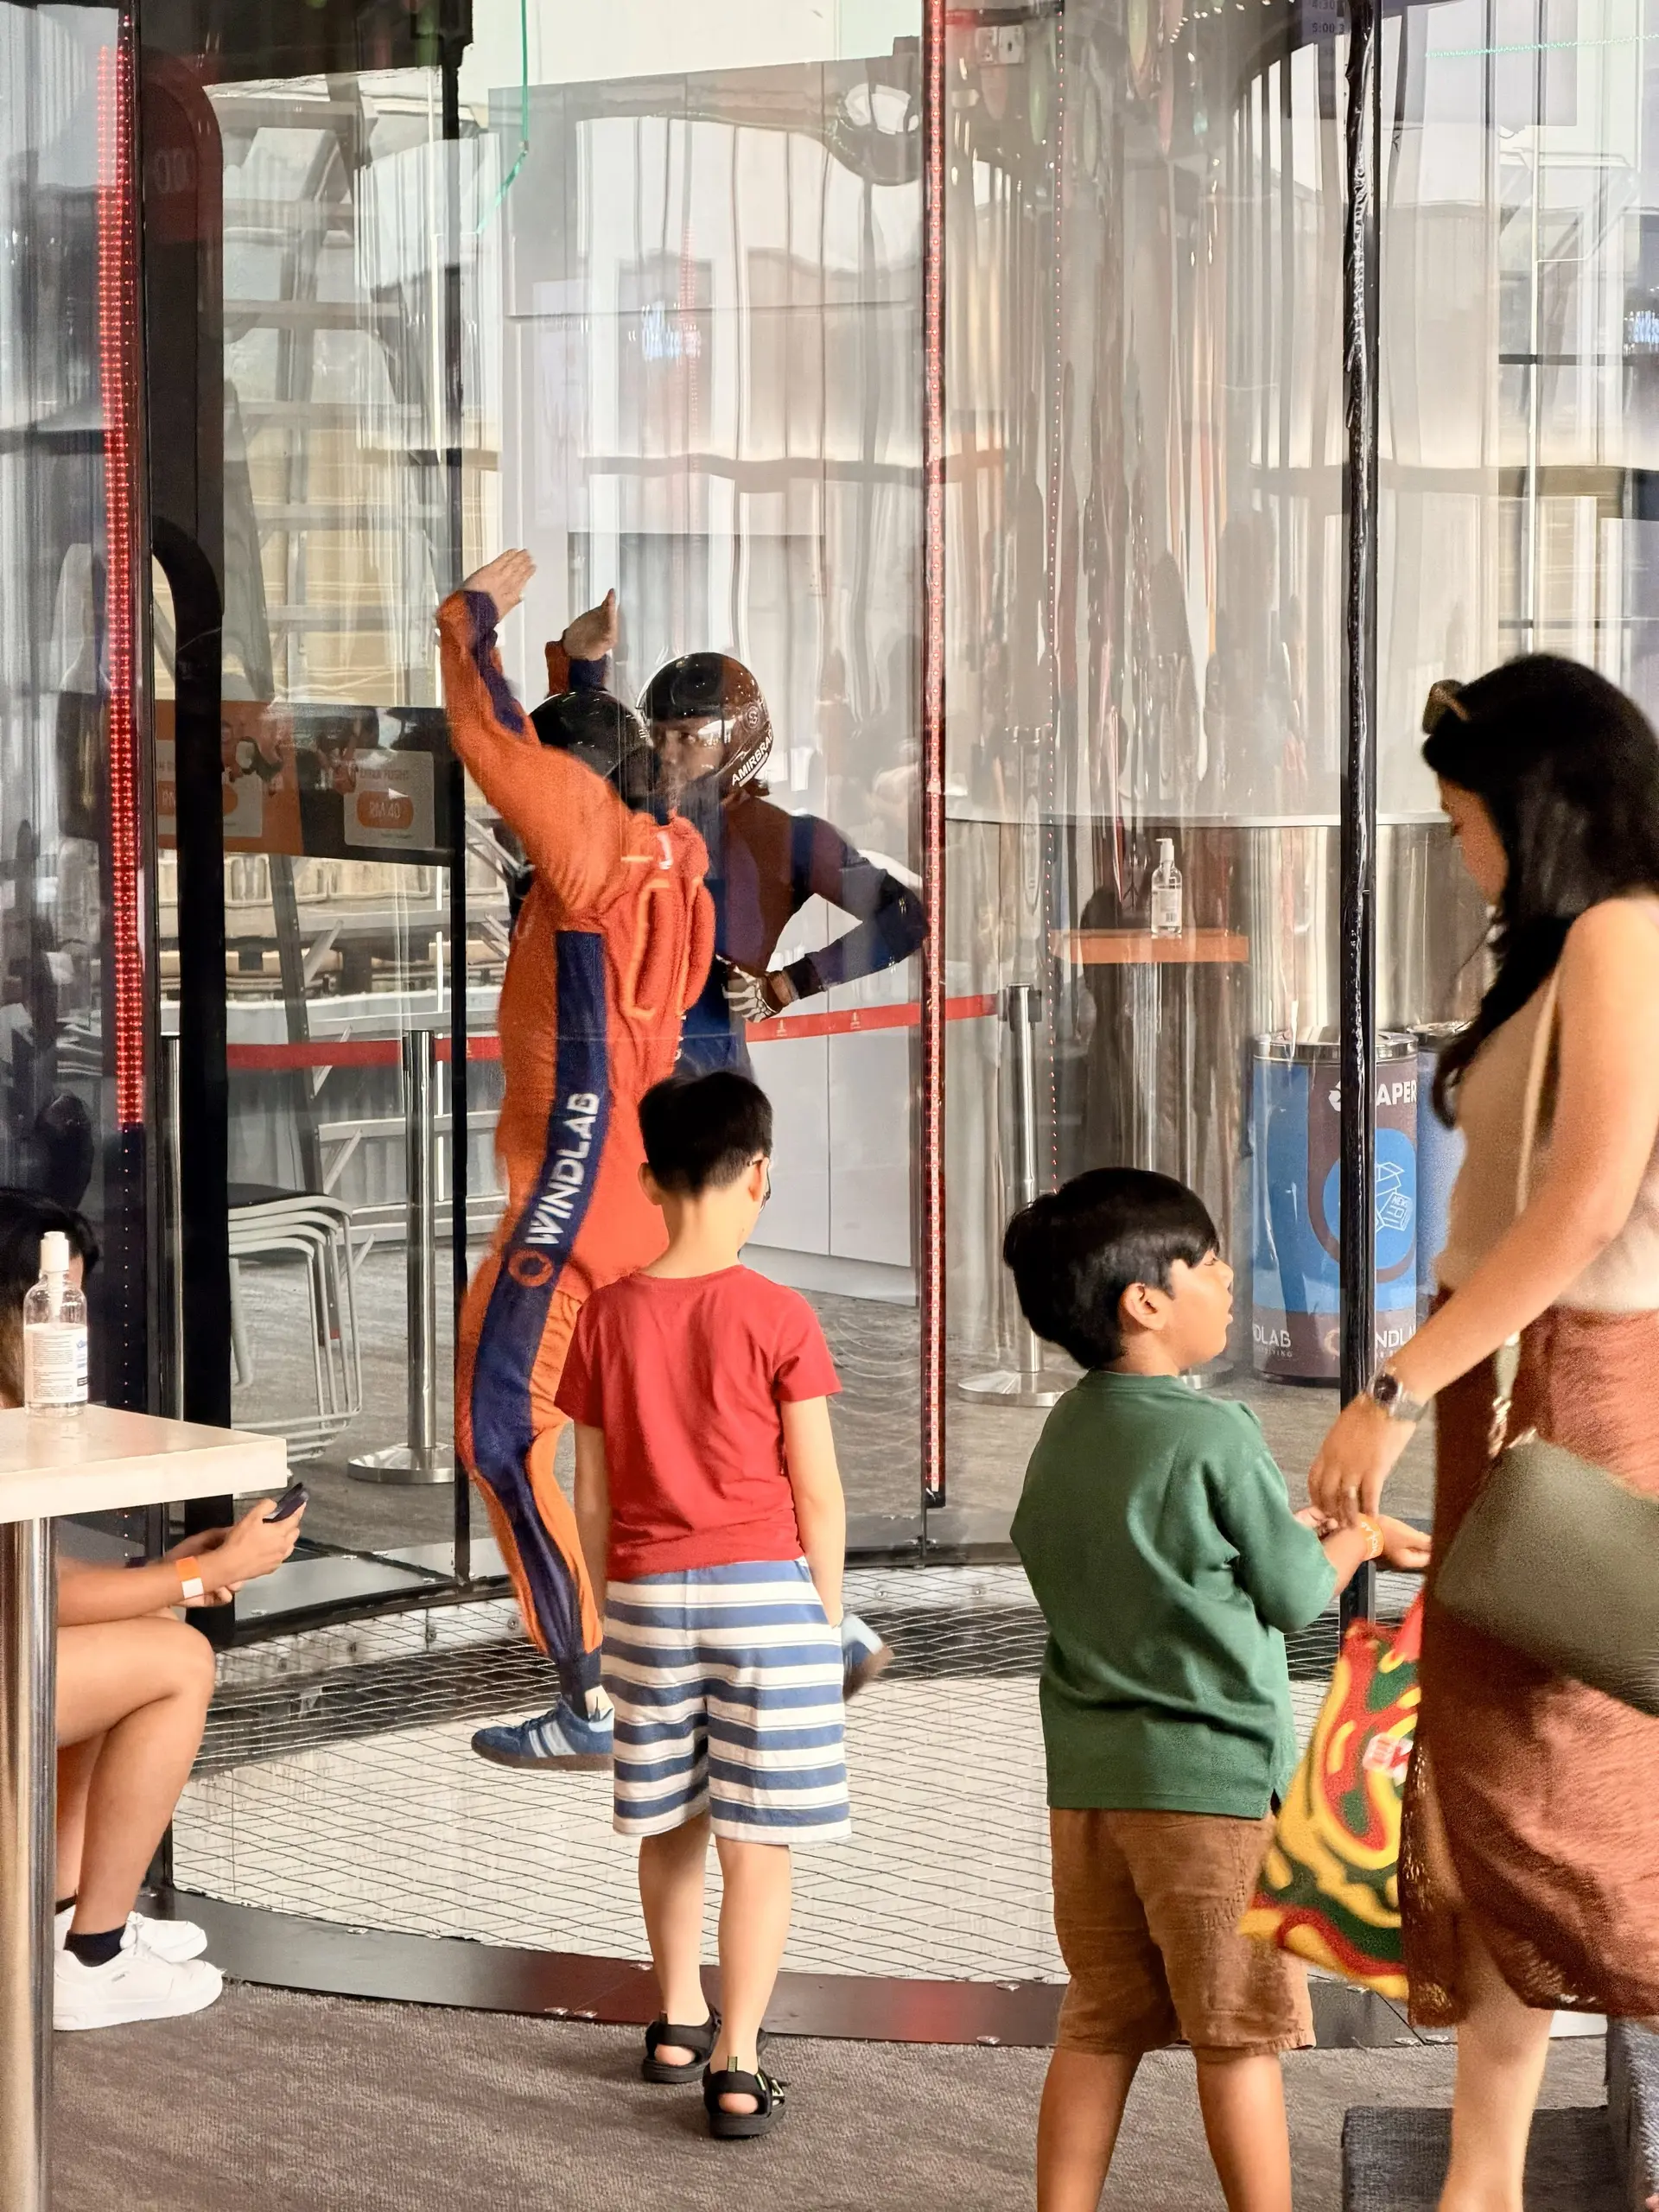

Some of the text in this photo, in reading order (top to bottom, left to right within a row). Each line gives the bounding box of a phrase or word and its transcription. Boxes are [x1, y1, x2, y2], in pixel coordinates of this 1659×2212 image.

[1313, 22, 1335, 33] 5:00
[387, 802, 401, 819] 40
[1376, 1080, 1417, 1106] APER
[524, 1092, 600, 1244] WINDLAB
[1252, 1324, 1291, 1348] DLAB
